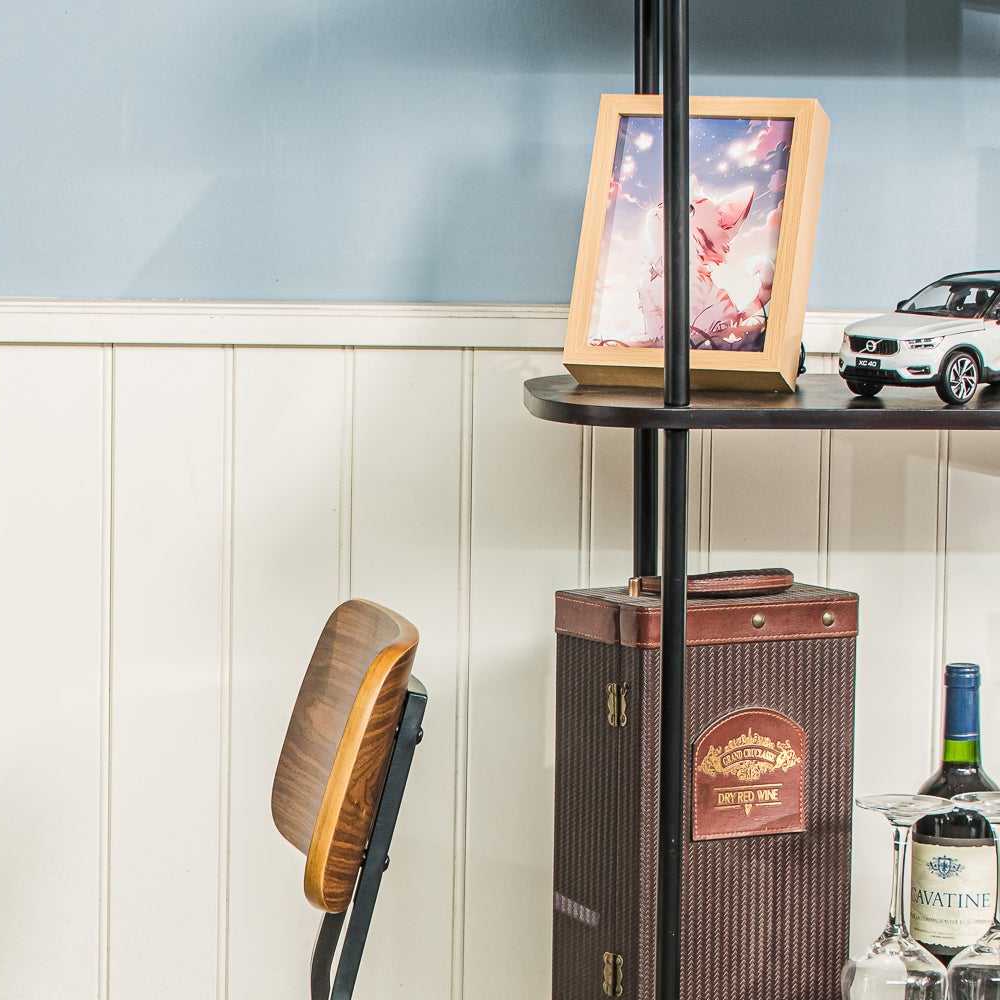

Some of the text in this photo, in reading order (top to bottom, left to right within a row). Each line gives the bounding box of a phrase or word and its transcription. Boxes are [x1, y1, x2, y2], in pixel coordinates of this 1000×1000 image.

[722, 750, 743, 766] GRAND
[717, 788, 779, 804] DRY RED WINE
